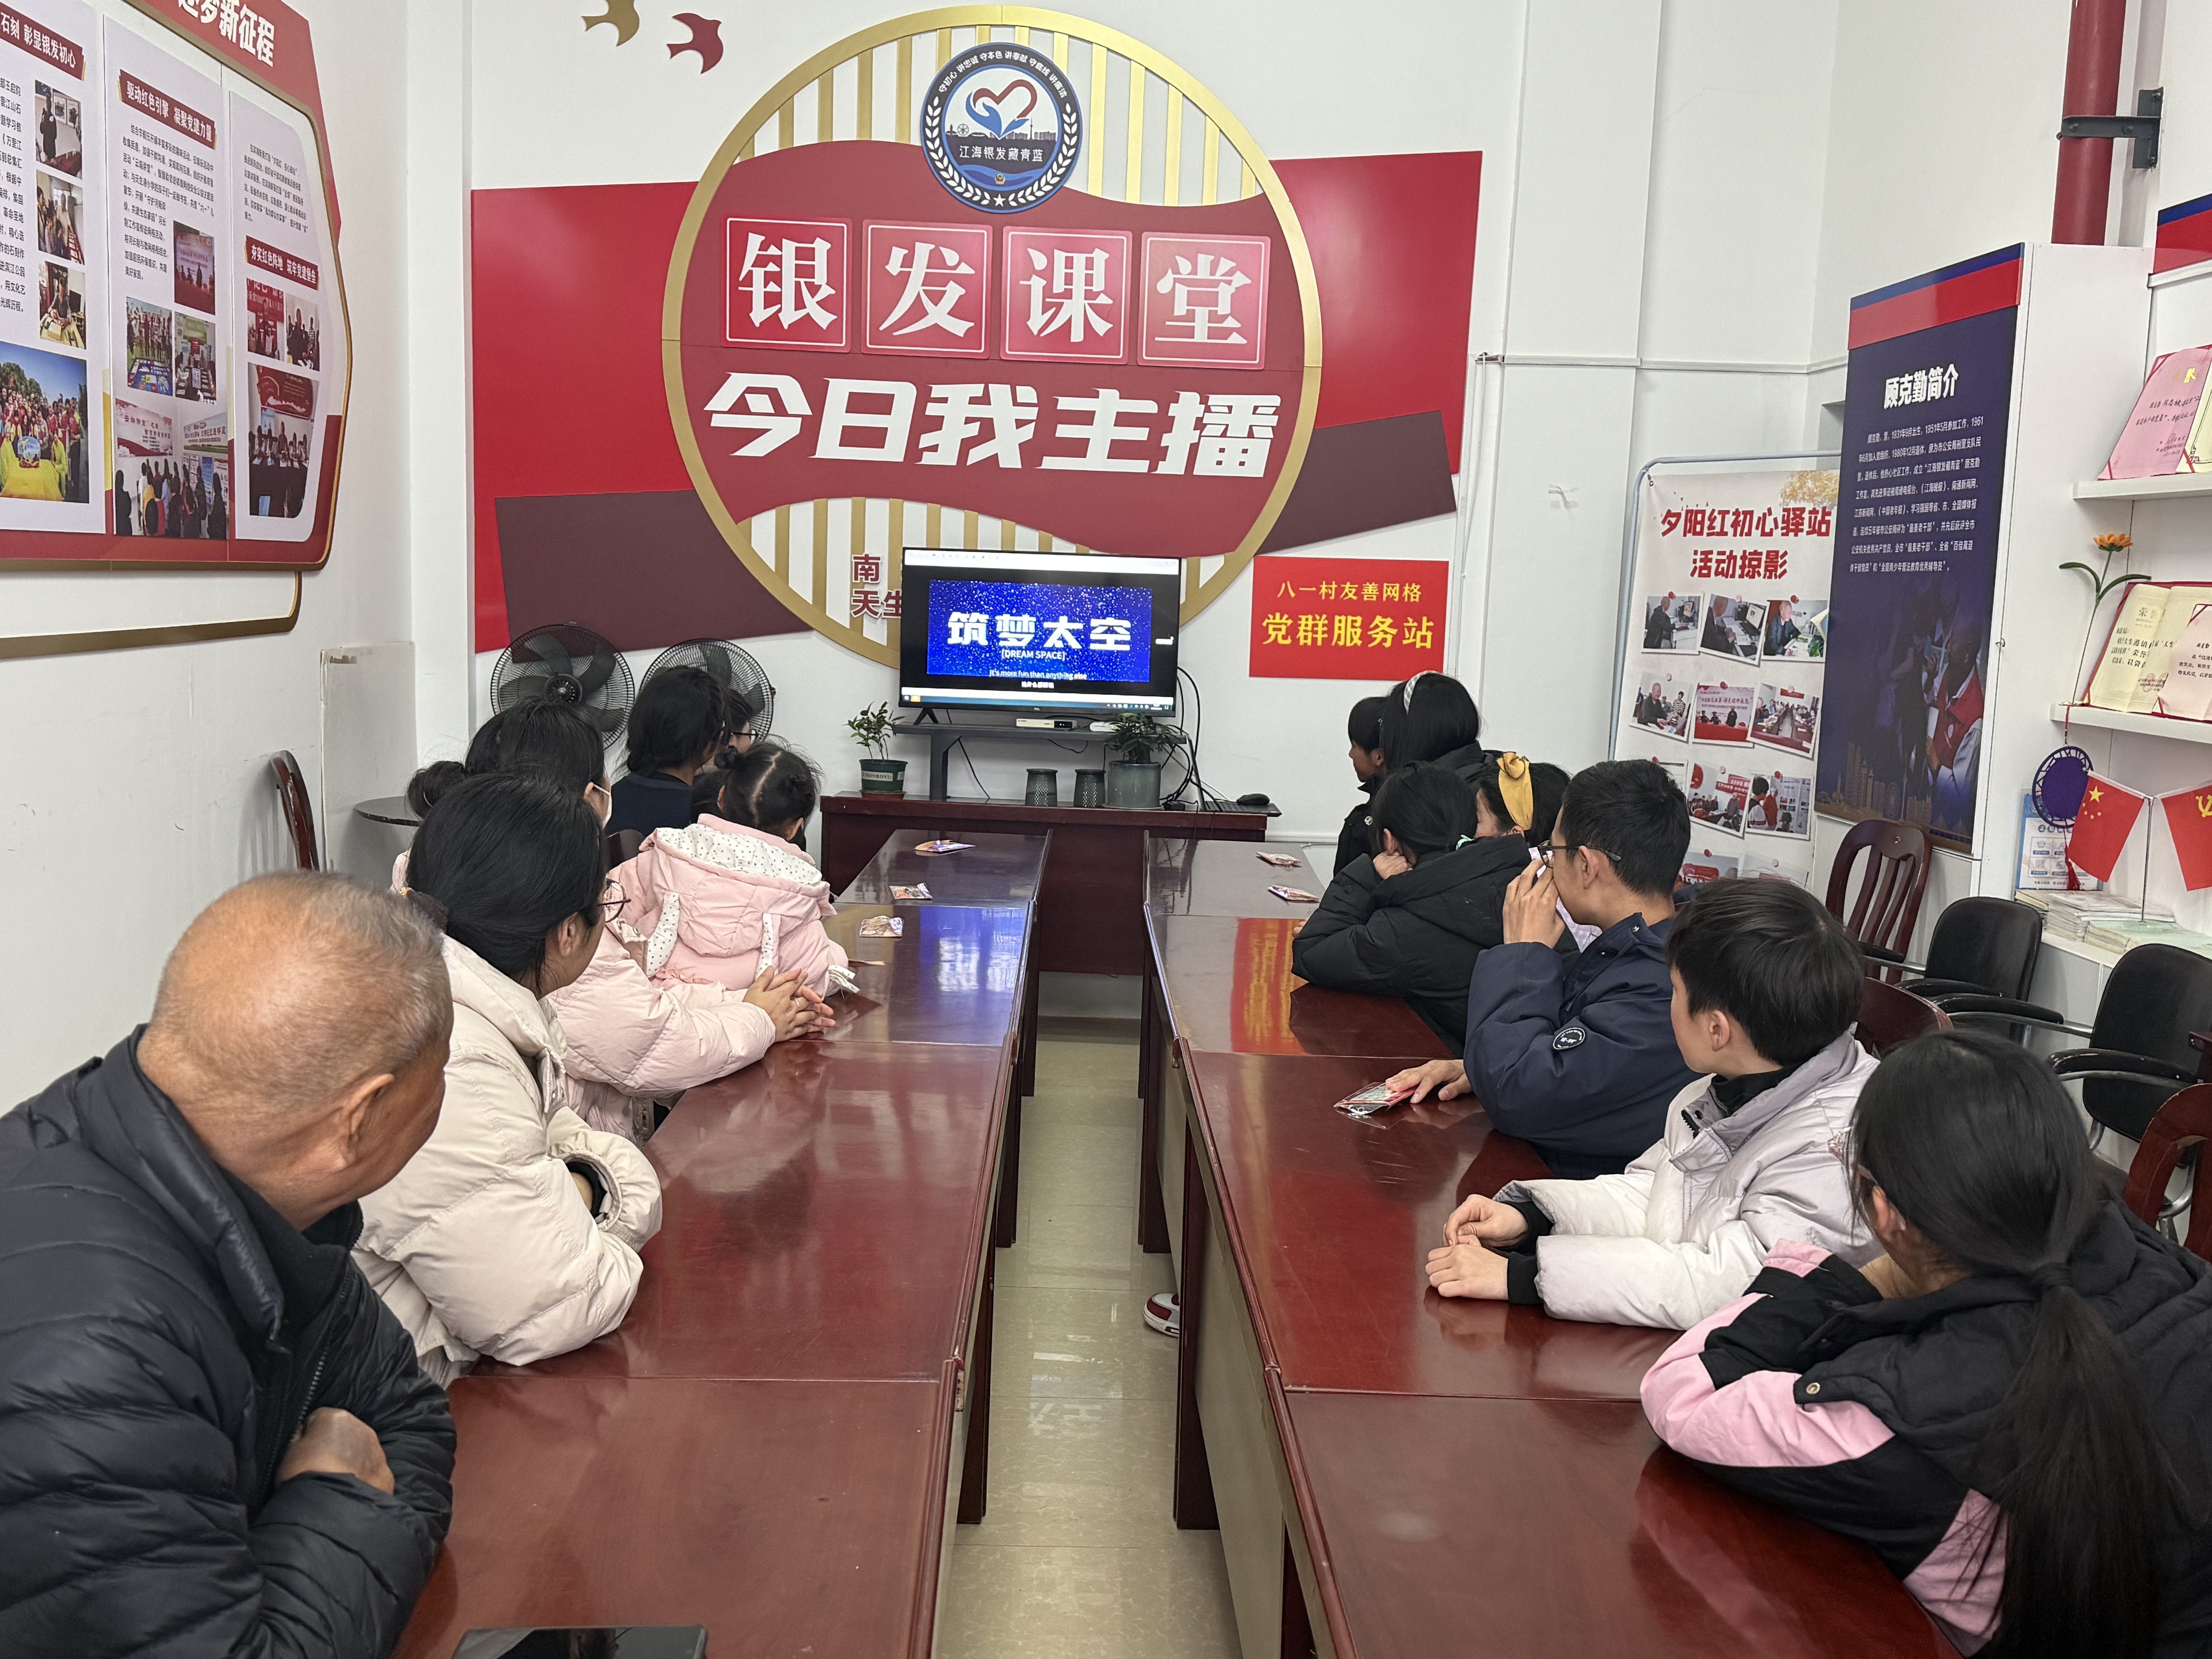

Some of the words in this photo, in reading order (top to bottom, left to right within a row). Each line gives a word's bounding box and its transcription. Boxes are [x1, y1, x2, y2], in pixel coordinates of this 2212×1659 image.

[24, 24, 76, 68] 彰显银发初心
[939, 72, 957, 93] 守初心
[957, 56, 979, 73] 讲忠诚
[980, 51, 1003, 61] 守本色
[1005, 51, 1028, 63] 讲奉献
[1029, 58, 1050, 76] 守底线
[1049, 74, 1068, 98] 讲廉洁
[127, 81, 169, 118] 驱动红色引擎
[174, 107, 212, 142] 凝聚党建力量
[960, 146, 1043, 162] 江海银发藏青蓝
[251, 244, 283, 270] 夯实红色阵地
[738, 232, 1251, 345] 银发课堂
[1884, 364, 1959, 409] 顾克勤简介
[704, 373, 1281, 478] 今日我主播
[1661, 506, 1831, 538] 夕阳红初心驿站
[852, 553, 881, 583] 南
[1690, 550, 1788, 580] 活动掠影
[1277, 581, 1422, 602] 八一村友善网格
[947, 611, 1132, 651] 筑梦太空
[1262, 613, 1434, 649] 党群服务站
[1046, 672, 1073, 680] anything
